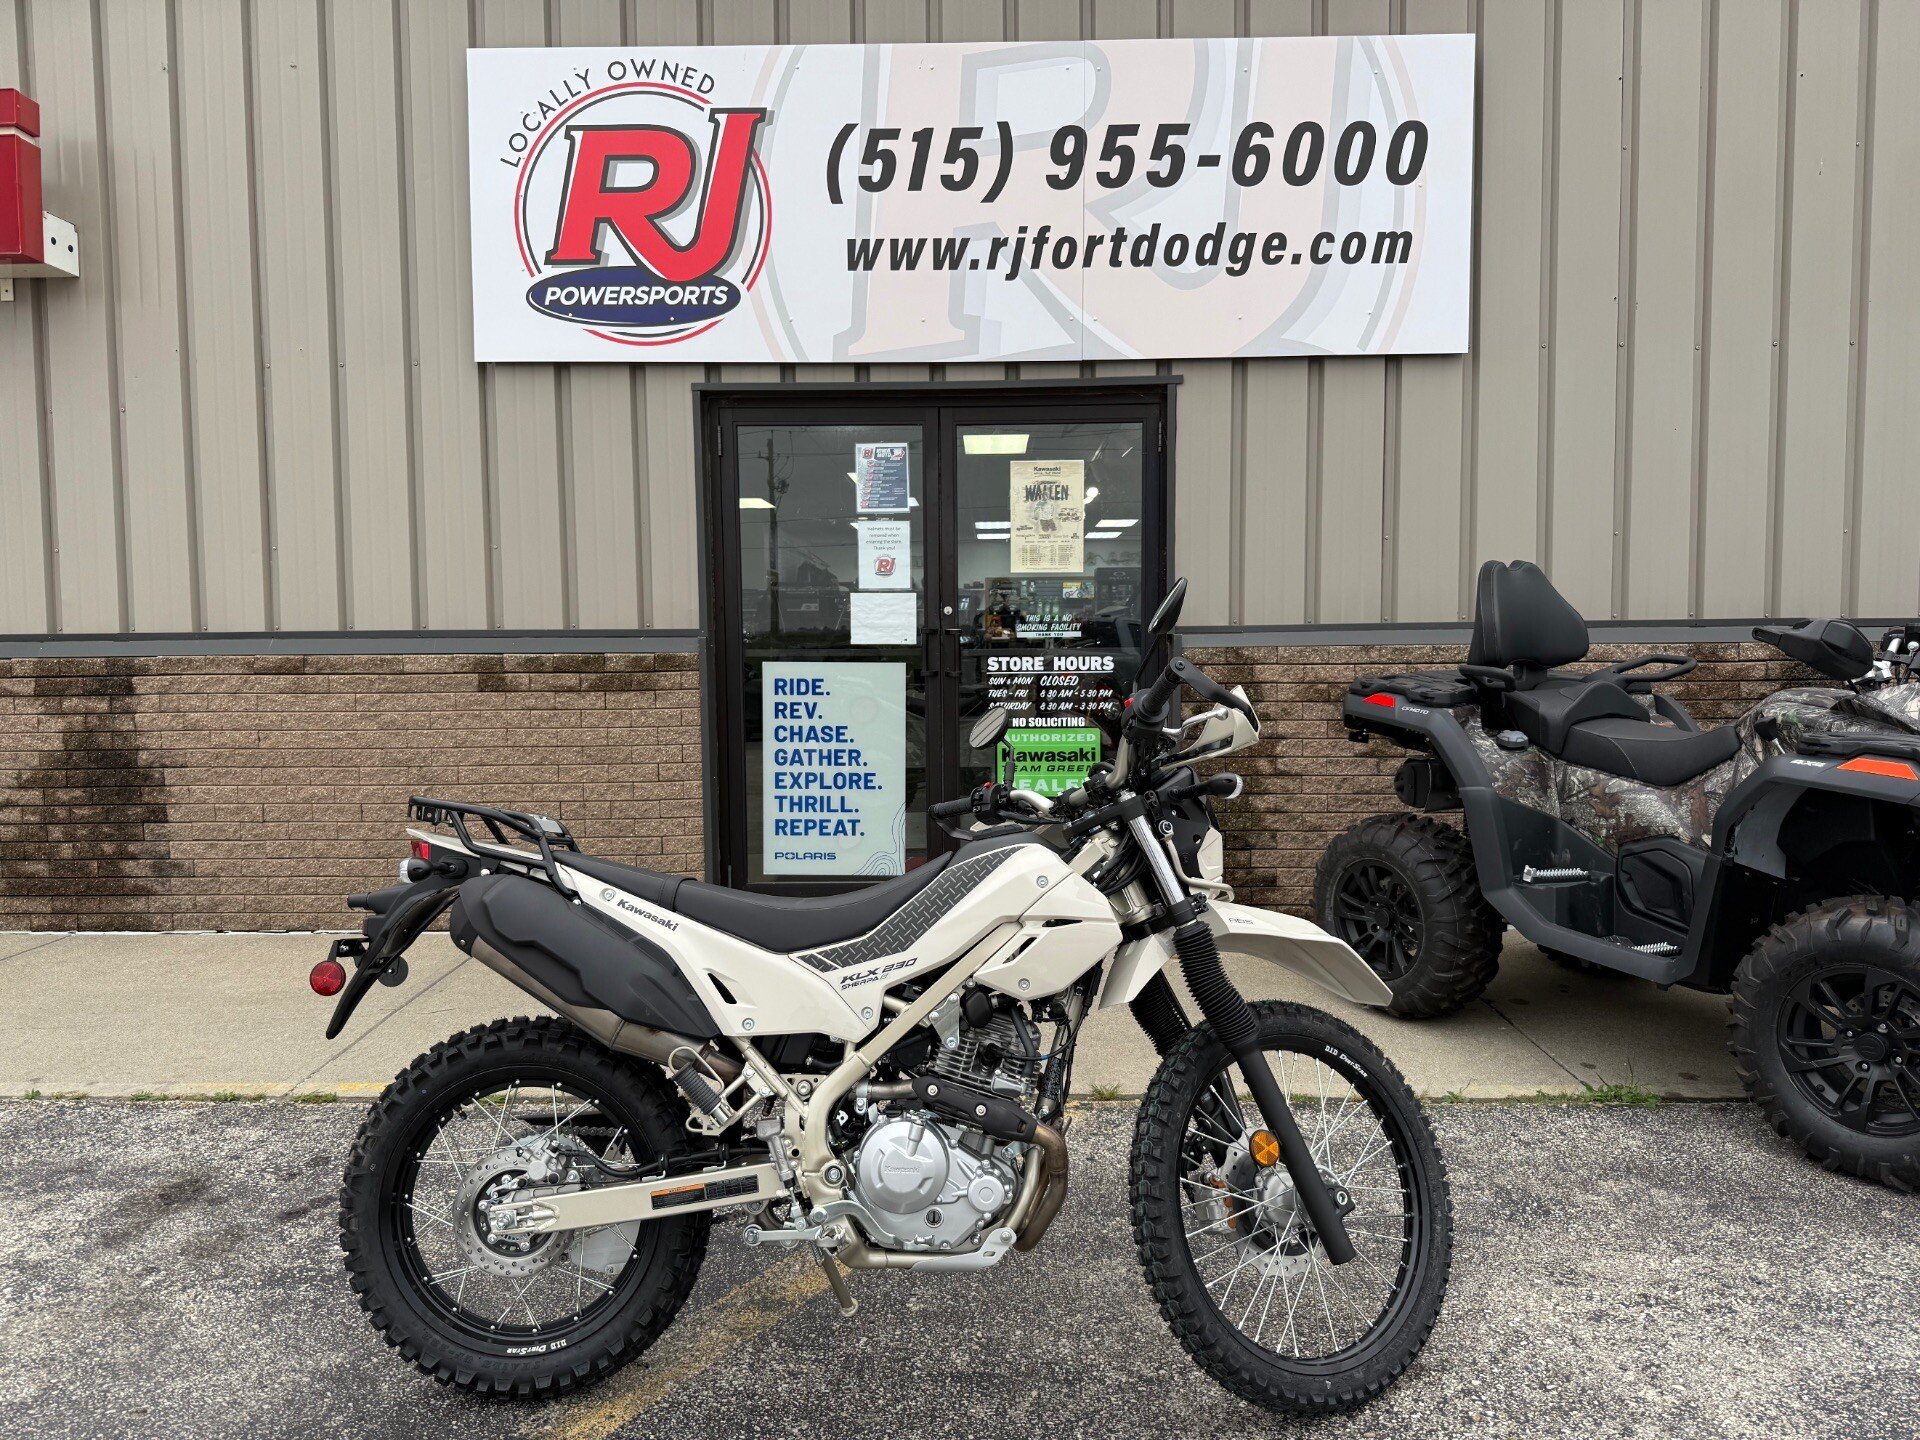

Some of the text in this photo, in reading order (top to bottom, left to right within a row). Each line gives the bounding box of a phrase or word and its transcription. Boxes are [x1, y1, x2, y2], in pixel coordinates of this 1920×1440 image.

[500, 58, 715, 168] LOCALLY OWNED
[826, 119, 1429, 204] (515) 955-6000
[543, 106, 769, 282] RJ
[846, 221, 1414, 281] www.rjfortdodge.com
[544, 283, 728, 307] POWERSPORTS
[1026, 613, 1073, 622] THIS IS A NO
[1016, 622, 1081, 631] SMOKING FACILITY
[987, 655, 1115, 671] STORE HOURS
[774, 678, 831, 696] RIDE.
[988, 676, 1007, 686] SUN
[1012, 676, 1034, 685] MON
[1040, 675, 1079, 687] CLOSED
[988, 689, 1008, 698] TUES
[1014, 689, 1029, 698] FRI
[1058, 689, 1074, 698] AM
[1098, 689, 1113, 698] PM
[774, 702, 823, 719] REV.
[1058, 701, 1074, 710] AM
[1401, 706, 1429, 715] CFMOTO
[1012, 716, 1086, 727] NO SOLICITING
[774, 725, 854, 743] CHASE.
[774, 748, 867, 766] GATHER.
[1001, 747, 1096, 762] Kawasaki
[1002, 764, 1042, 772] EAM
[774, 772, 882, 790] EXPLORE.
[1000, 778, 1086, 793] EALE
[774, 795, 859, 813] THRILL.
[774, 819, 865, 836] REPEAT.
[775, 852, 837, 860] POLARIS
[617, 899, 679, 931] Kawasaki
[840, 957, 918, 984] KLX 230
[841, 976, 879, 990] SHERPA
